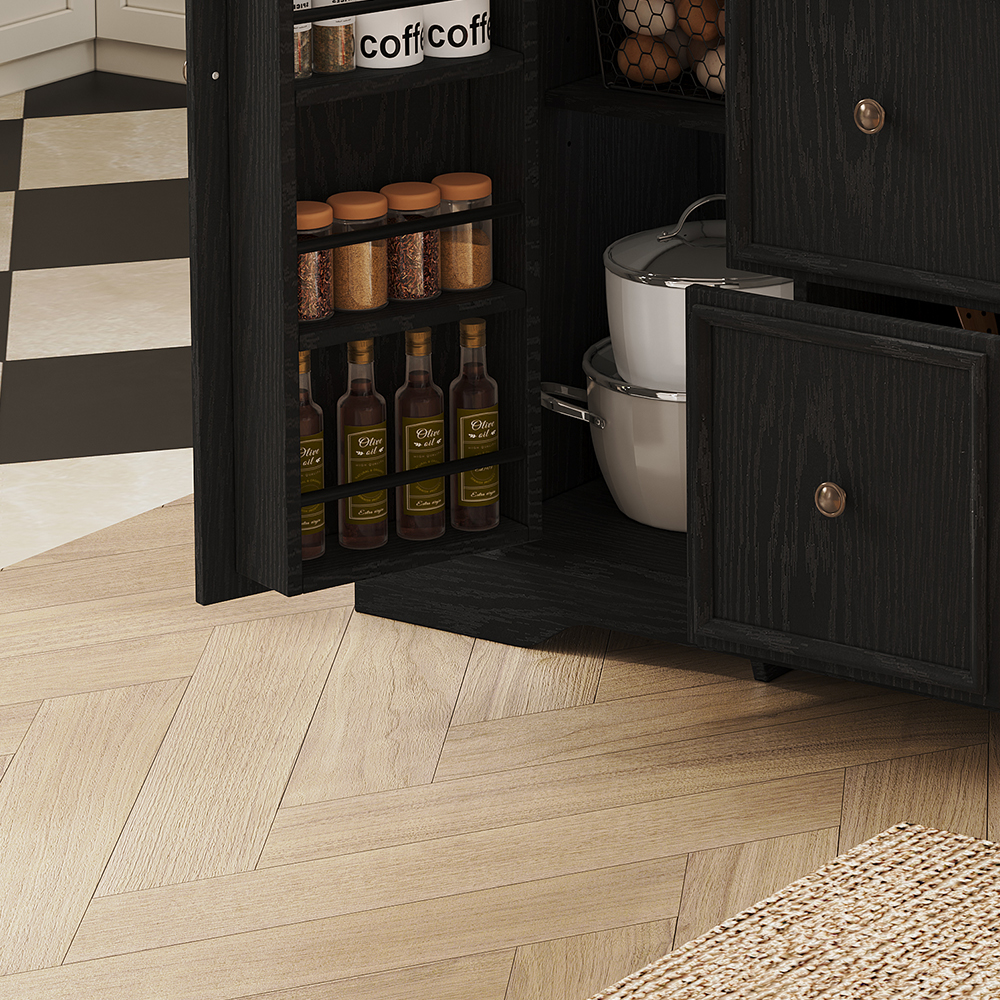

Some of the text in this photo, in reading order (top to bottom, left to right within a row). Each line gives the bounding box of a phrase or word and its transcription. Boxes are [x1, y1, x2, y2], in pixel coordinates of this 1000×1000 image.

[470, 419, 495, 431] Olive
[416, 428, 440, 439] Olive
[478, 429, 489, 438] oil
[358, 436, 382, 448] Olive
[424, 438, 435, 446] oil
[366, 446, 376, 455] oil
[302, 457, 314, 466] oil
